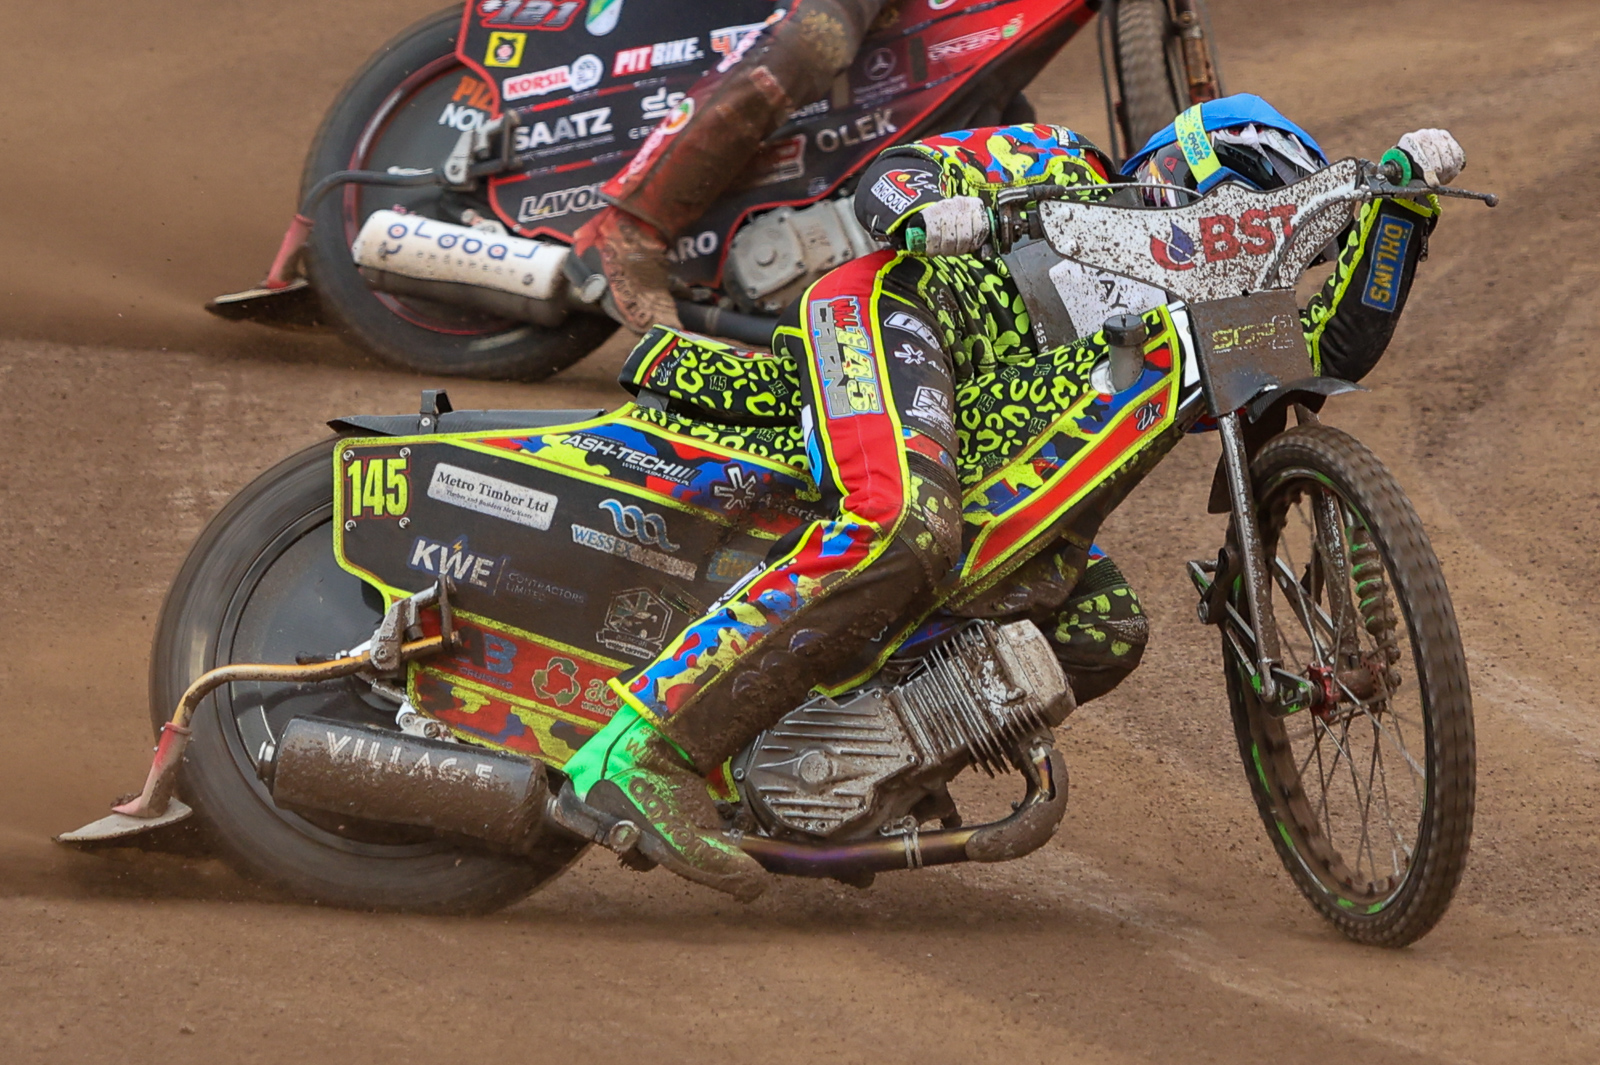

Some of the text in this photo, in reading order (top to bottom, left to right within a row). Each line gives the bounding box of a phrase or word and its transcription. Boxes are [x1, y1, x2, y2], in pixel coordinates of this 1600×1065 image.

[508, 71, 570, 95] KORSIL
[816, 108, 897, 152] OLEK
[1200, 204, 1297, 263] BST
[1368, 223, 1408, 303] ÖHLINS
[813, 302, 851, 416] CAIRNS
[836, 328, 879, 412] 145
[1001, 367, 1020, 382] 145
[709, 375, 727, 391] 145
[757, 429, 776, 442] 145
[347, 458, 408, 517] 145
[437, 472, 549, 513] Metro Timber Ltd
[411, 539, 495, 588] KWE
[508, 572, 585, 604] CONTRACTORS
[326, 731, 494, 790] VILLAGE
